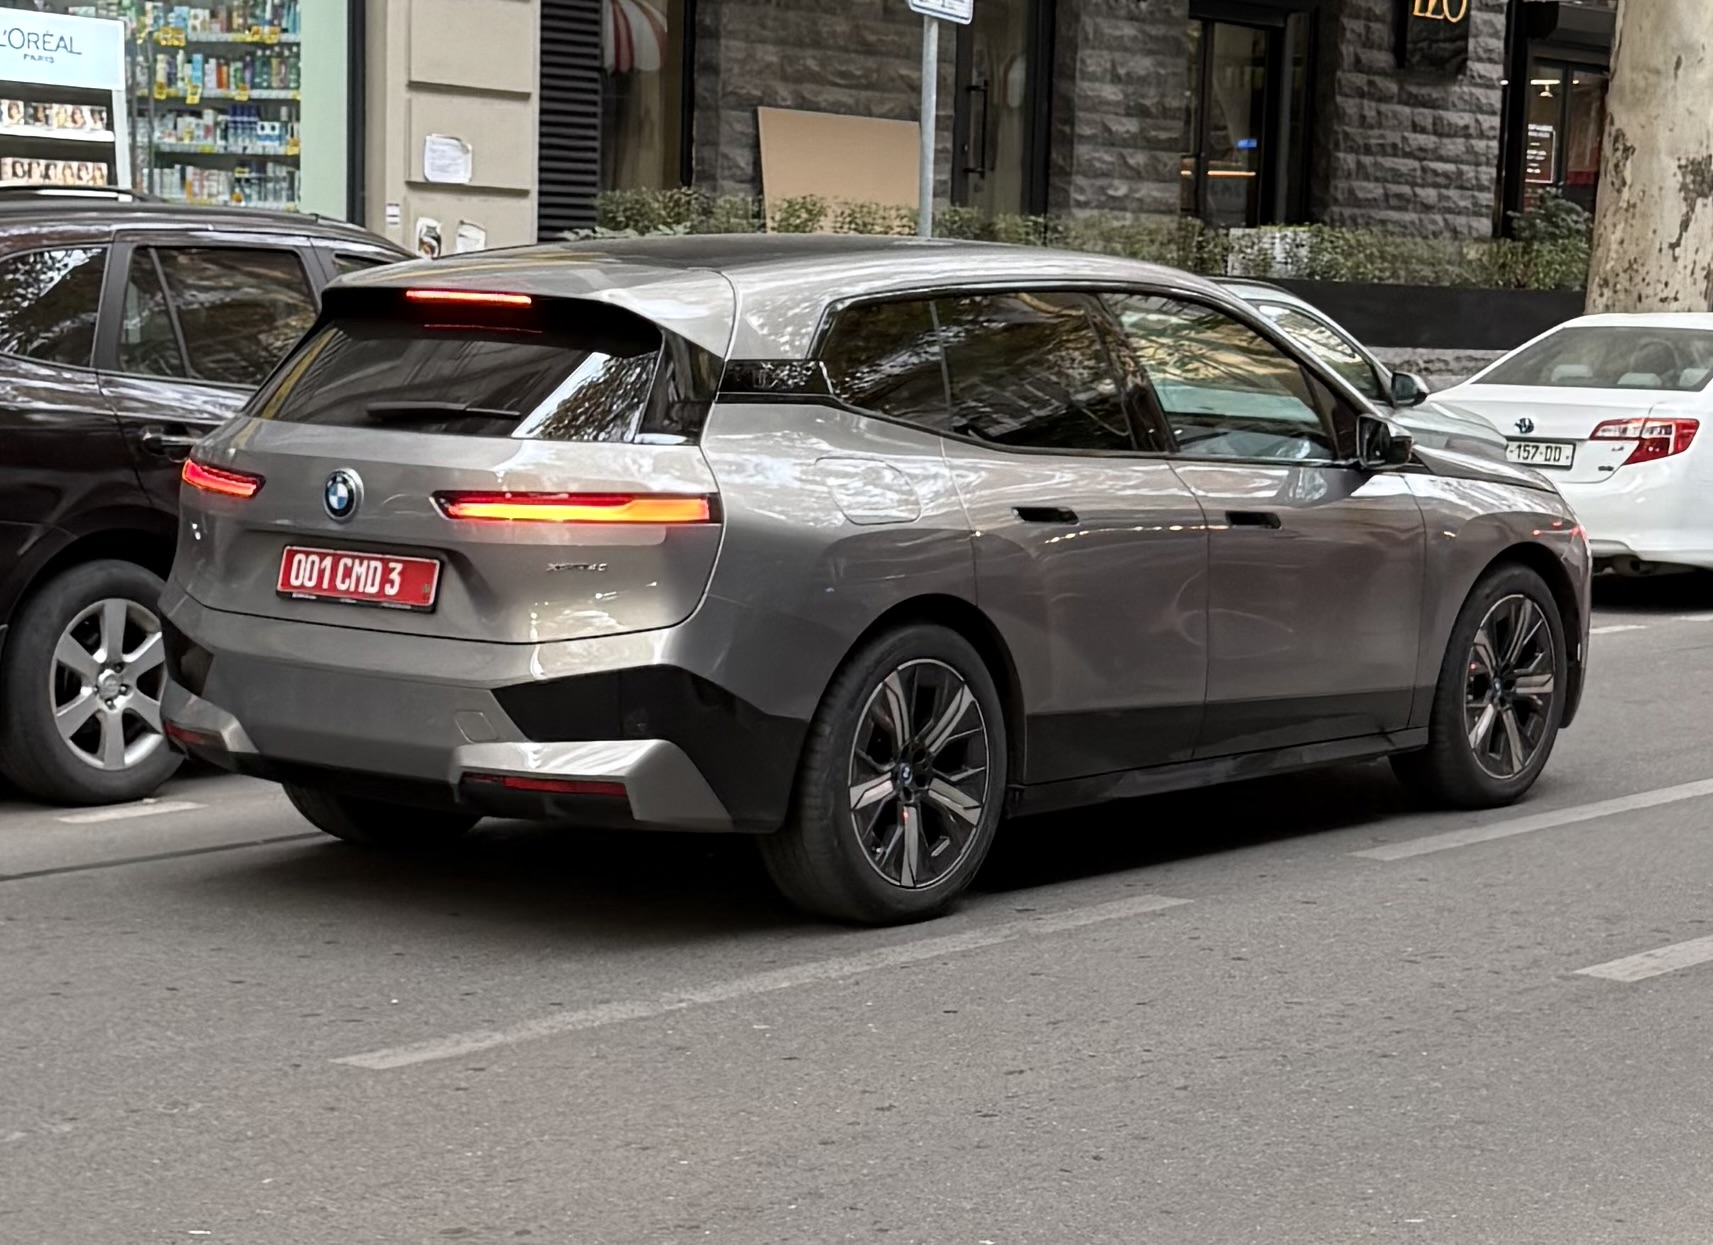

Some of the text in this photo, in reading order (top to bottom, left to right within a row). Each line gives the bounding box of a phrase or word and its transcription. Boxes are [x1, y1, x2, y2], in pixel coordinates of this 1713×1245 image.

[1505, 443, 1562, 462] -157-DD
[290, 553, 403, 596] 001 CMD 3
